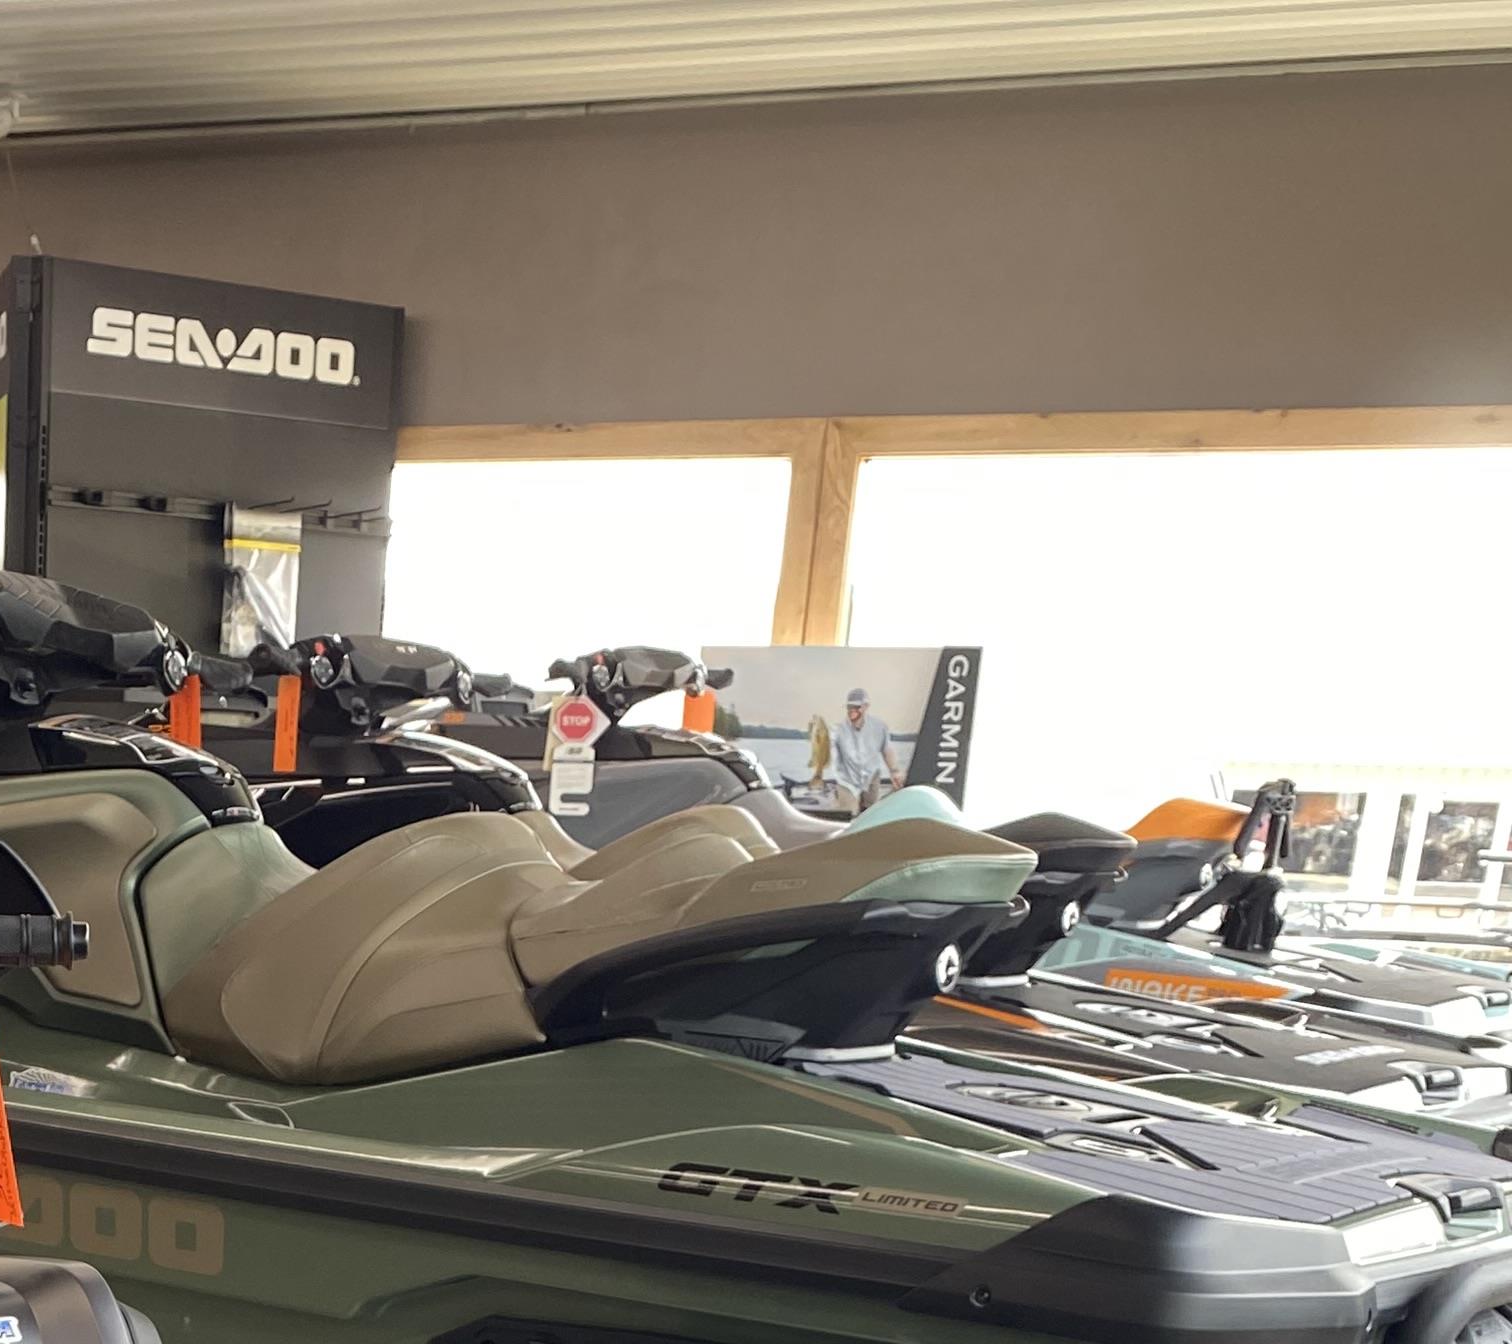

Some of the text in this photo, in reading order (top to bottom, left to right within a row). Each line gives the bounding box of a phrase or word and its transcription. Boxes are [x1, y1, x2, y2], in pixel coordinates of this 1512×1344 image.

[562, 714, 590, 726] STOP
[936, 654, 969, 783] GARMIN
[658, 1162, 960, 1215] GTX LIMITED
